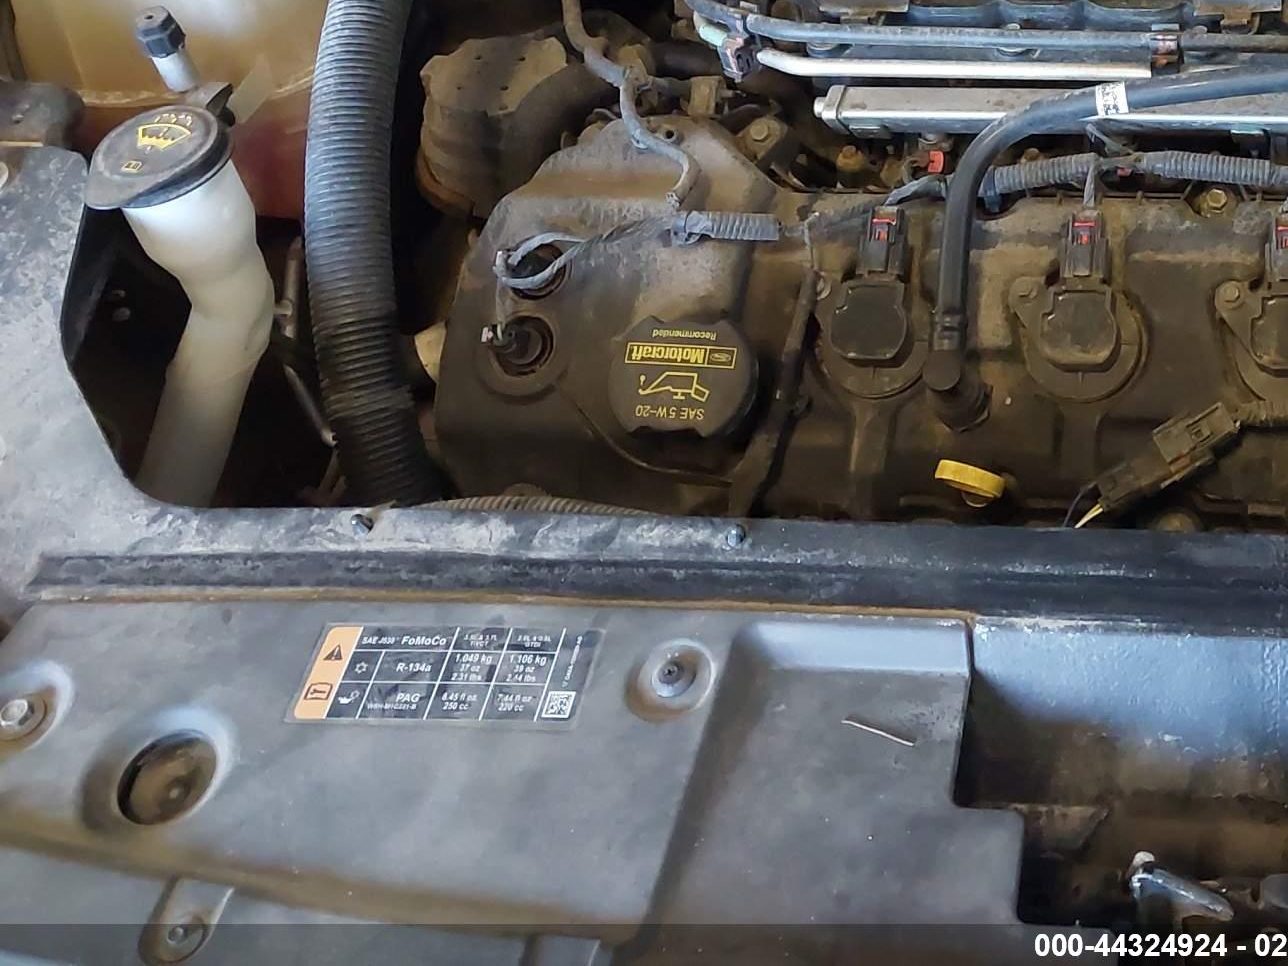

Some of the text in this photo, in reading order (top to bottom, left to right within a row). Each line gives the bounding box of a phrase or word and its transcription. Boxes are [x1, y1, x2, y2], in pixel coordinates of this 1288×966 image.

[652, 329, 717, 341] Recommended
[631, 346, 706, 363] Motorcraft
[680, 408, 704, 420] SAE
[362, 636, 379, 644] SAE
[401, 636, 446, 646] FoMoCo
[456, 654, 493, 664] 1.049 kg
[510, 654, 547, 666] 1.106 kg
[396, 662, 432, 672] R-134a
[460, 664, 469, 672] 37
[451, 673, 468, 681] 2.31
[524, 674, 536, 682] lbs
[396, 692, 421, 702] PAG
